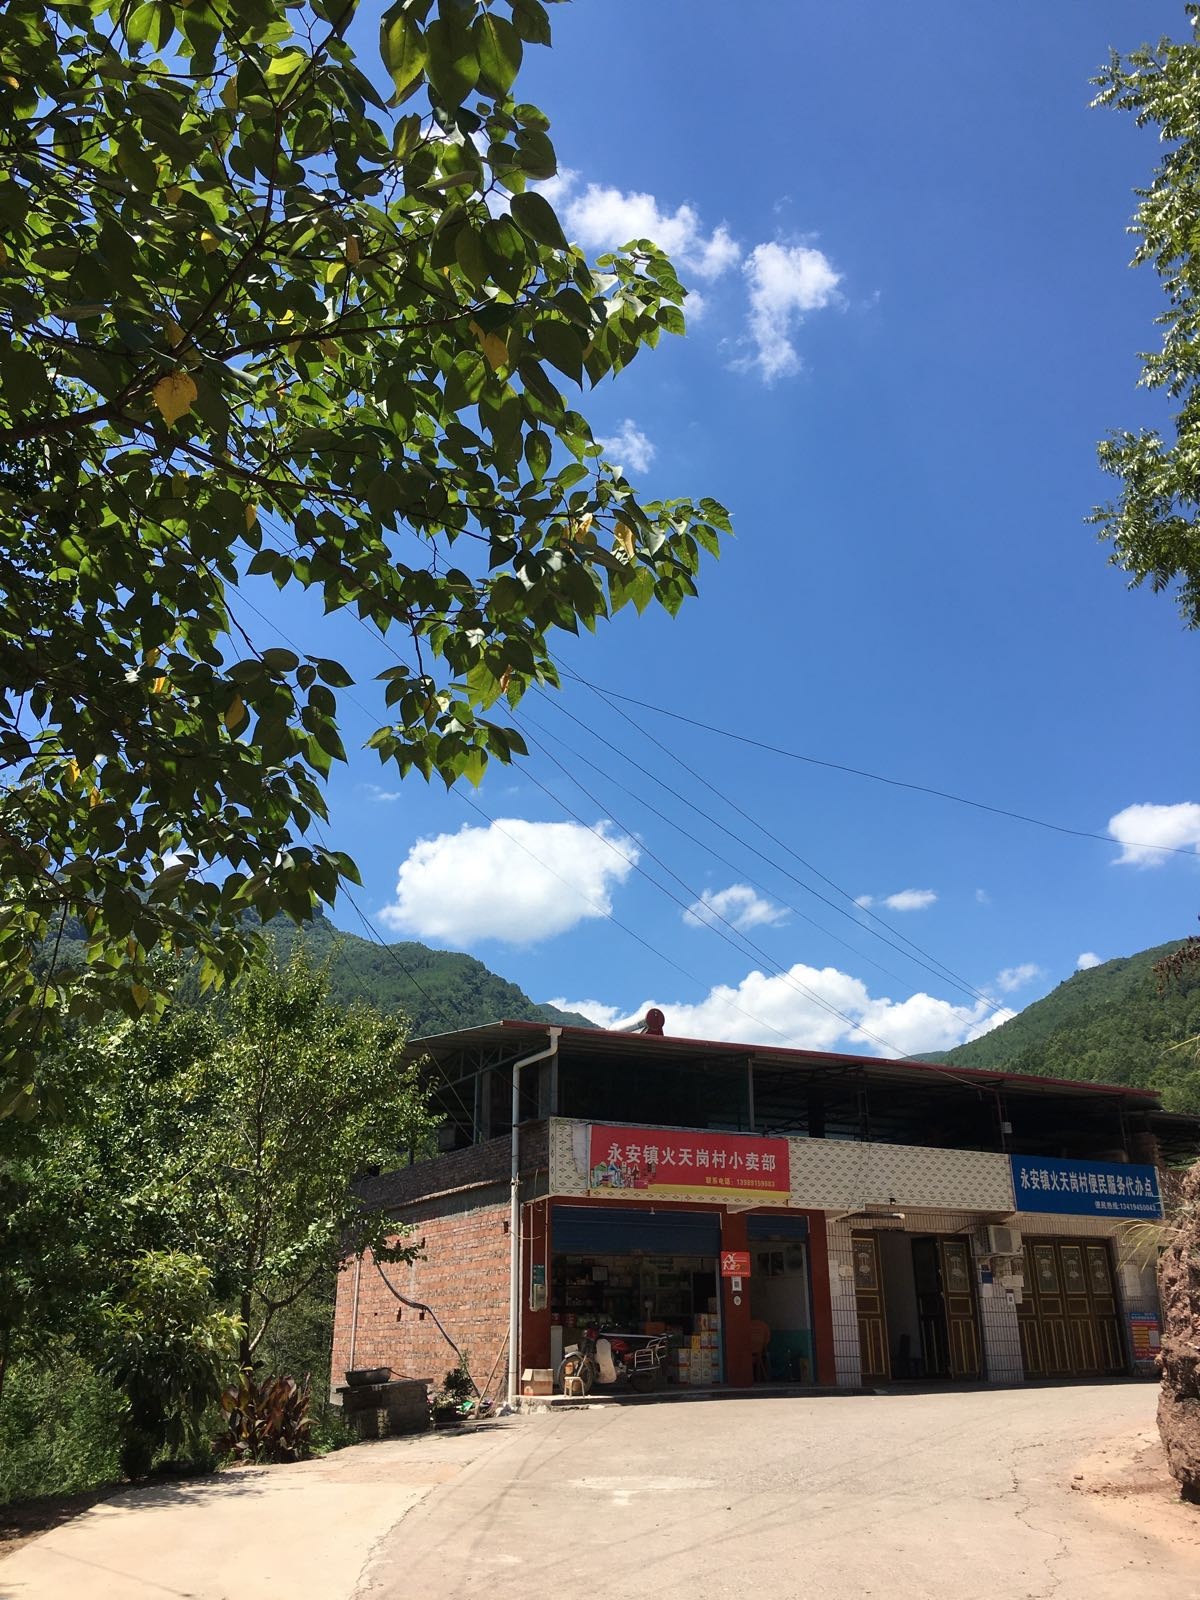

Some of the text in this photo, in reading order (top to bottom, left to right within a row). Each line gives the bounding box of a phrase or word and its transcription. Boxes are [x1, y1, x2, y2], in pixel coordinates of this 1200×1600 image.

[607, 1142, 776, 1173] 永安镇火天岗村小卖部
[1020, 1167, 1153, 1197] 永安镇火天岗村便民服务代办点
